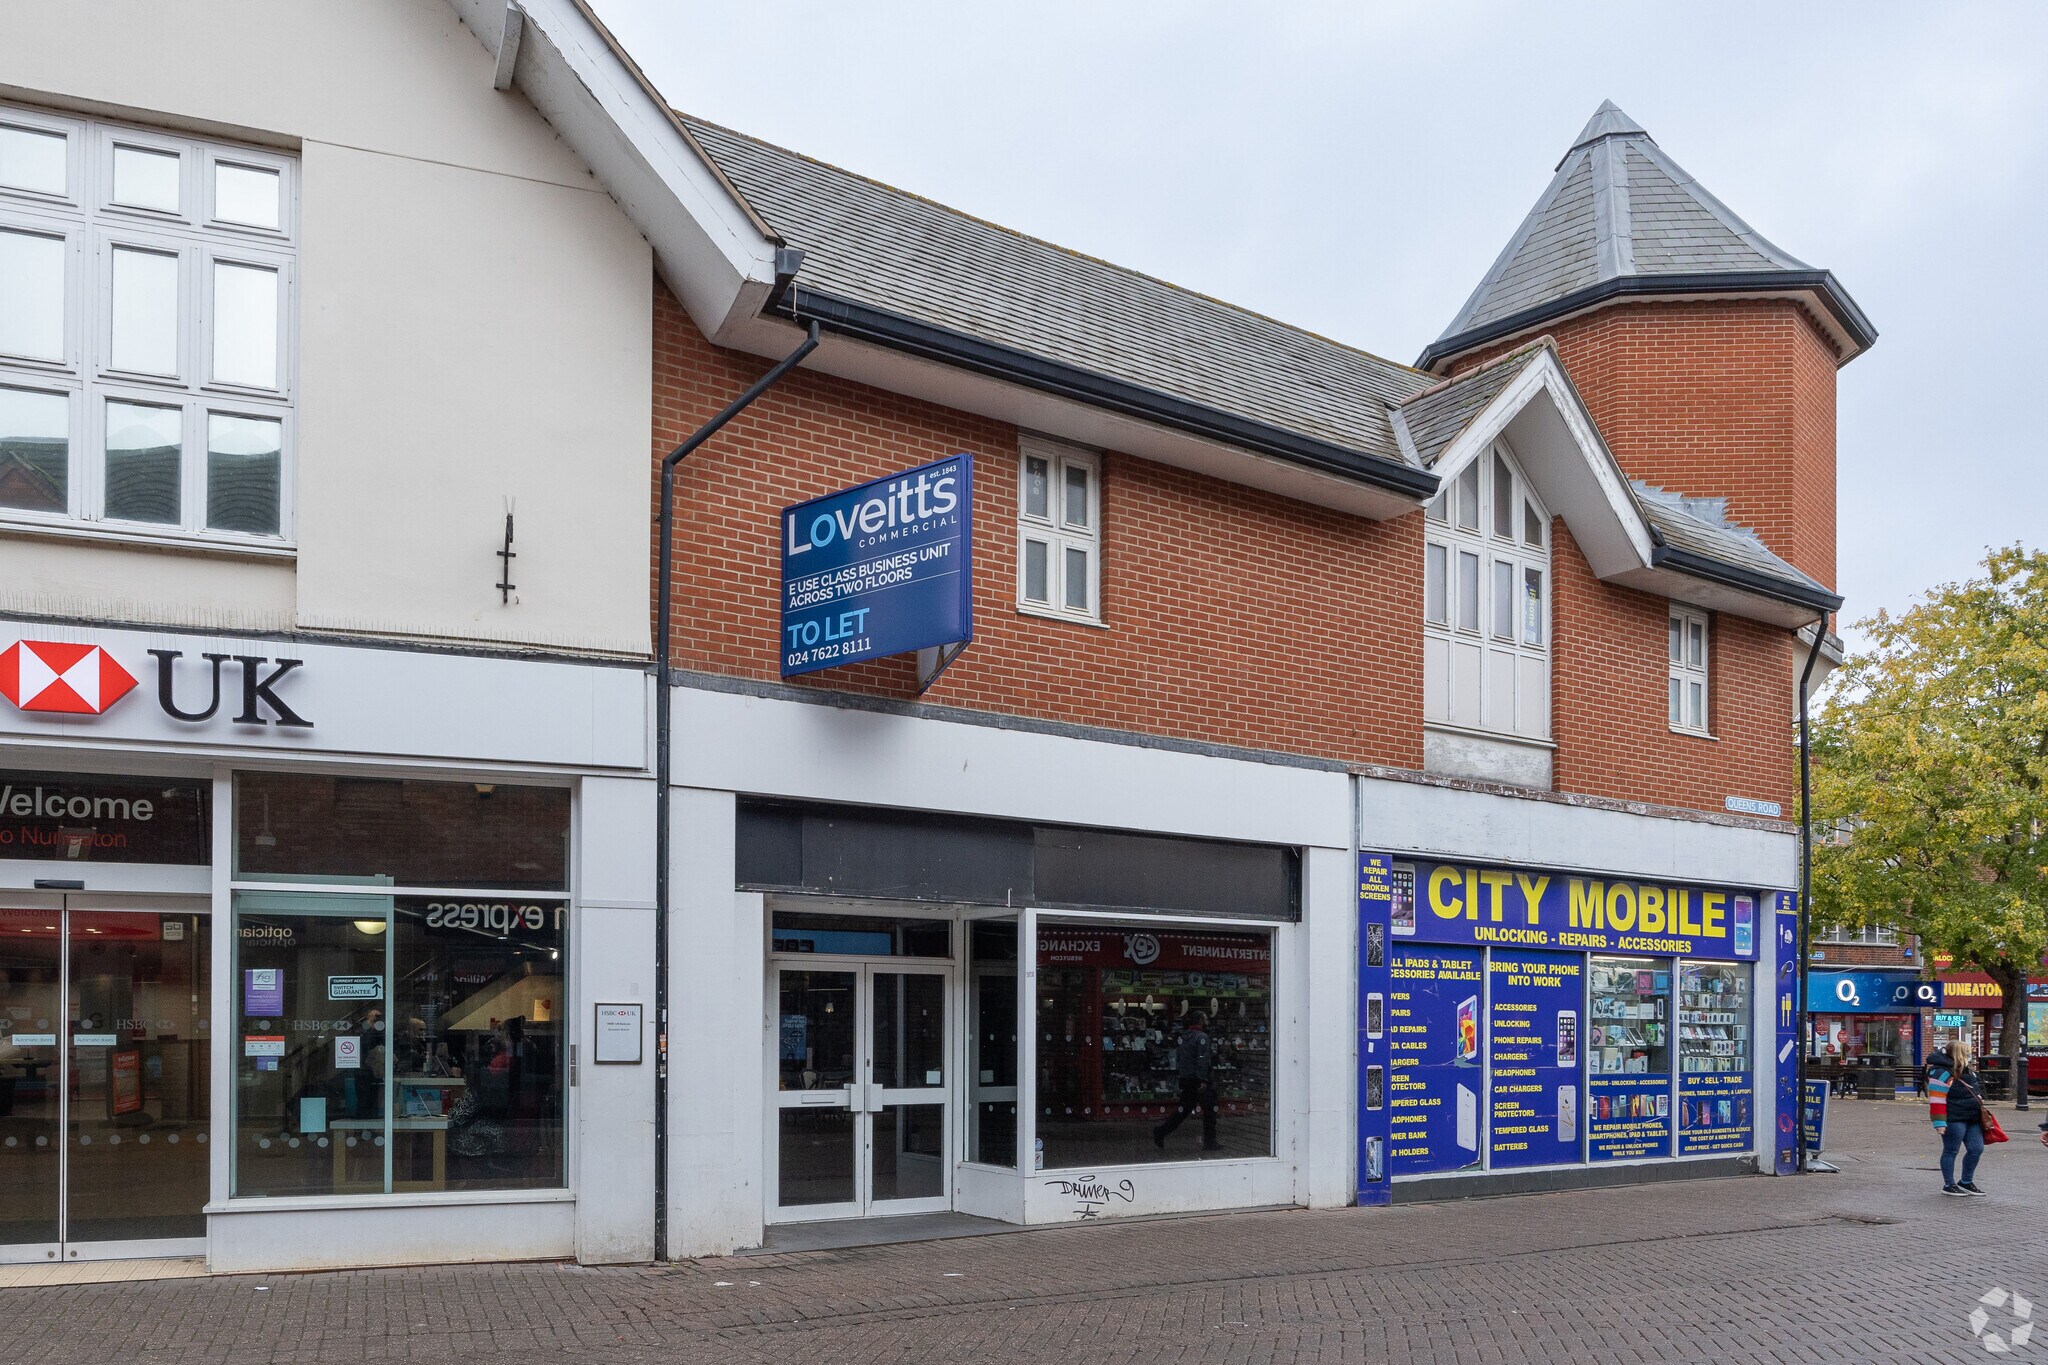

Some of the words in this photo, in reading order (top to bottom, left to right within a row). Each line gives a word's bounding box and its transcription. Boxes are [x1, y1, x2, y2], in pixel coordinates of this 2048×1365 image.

[930, 470, 940, 479] est.
[941, 465, 957, 476] 1843
[788, 474, 957, 556] Loveitts
[859, 515, 957, 548] COMMERCIAL
[789, 584, 796, 596] E
[797, 577, 819, 593] USE
[821, 567, 857, 587] CLASS
[859, 551, 918, 577] BUSINESS
[920, 543, 951, 562] UNIT
[789, 587, 834, 609] ACROSS
[835, 579, 863, 597] TWO
[865, 567, 912, 589] FLOORS
[788, 620, 820, 649] TO
[825, 607, 870, 642] LET
[788, 651, 809, 667] 024
[811, 643, 840, 662] 7622
[842, 637, 871, 655] 8111
[147, 649, 315, 729] UK
[1728, 798, 1756, 812] QUEENS
[1758, 802, 1779, 814] ROAD
[21, 826, 127, 848] Nunton
[1370, 859, 1381, 867] WE
[1363, 867, 1388, 876] REPAIR
[1361, 884, 1390, 892] BROKEN
[1360, 892, 1391, 901] SCREENS
[1428, 865, 1551, 925] CITY
[1569, 879, 1726, 938] MOBILE
[1474, 926, 1548, 944] UNLOCKING
[1559, 932, 1607, 948] REPAIRS
[1618, 936, 1692, 953] ACCESSORIES
[1405, 958, 1430, 968] IPADS
[1432, 960, 1438, 968] &
[1441, 960, 1472, 970] TABLET
[1490, 962, 1518, 973] BRING
[1522, 963, 1546, 974] YOUR
[1549, 964, 1580, 976] PHONE
[1438, 970, 1481, 981] AVAILABLE
[1508, 975, 1530, 986] INTO
[1533, 976, 1562, 987] WORK
[1836, 980, 1860, 1006] O2
[1918, 986, 1936, 1002] O2
[1494, 1004, 1538, 1012] ACCESSORIES
[116, 1019, 153, 1030] HSBC
[293, 1020, 331, 1031] HSBC
[1494, 1068, 1536, 1076] HEADPHONES
[1494, 1086, 1508, 1094] CAR
[1509, 1084, 1542, 1093] CHARGERS
[1420, 1098, 1442, 1106] GLASS
[1494, 1110, 1535, 1118] PROTECTORS
[1408, 1131, 1427, 1139] BANK
[1494, 1126, 1528, 1134] TEMPERED
[1528, 1124, 1549, 1132] GLASS
[1398, 1148, 1429, 1156] HOLDERS
[1494, 1142, 1528, 1152] BATTERIES
